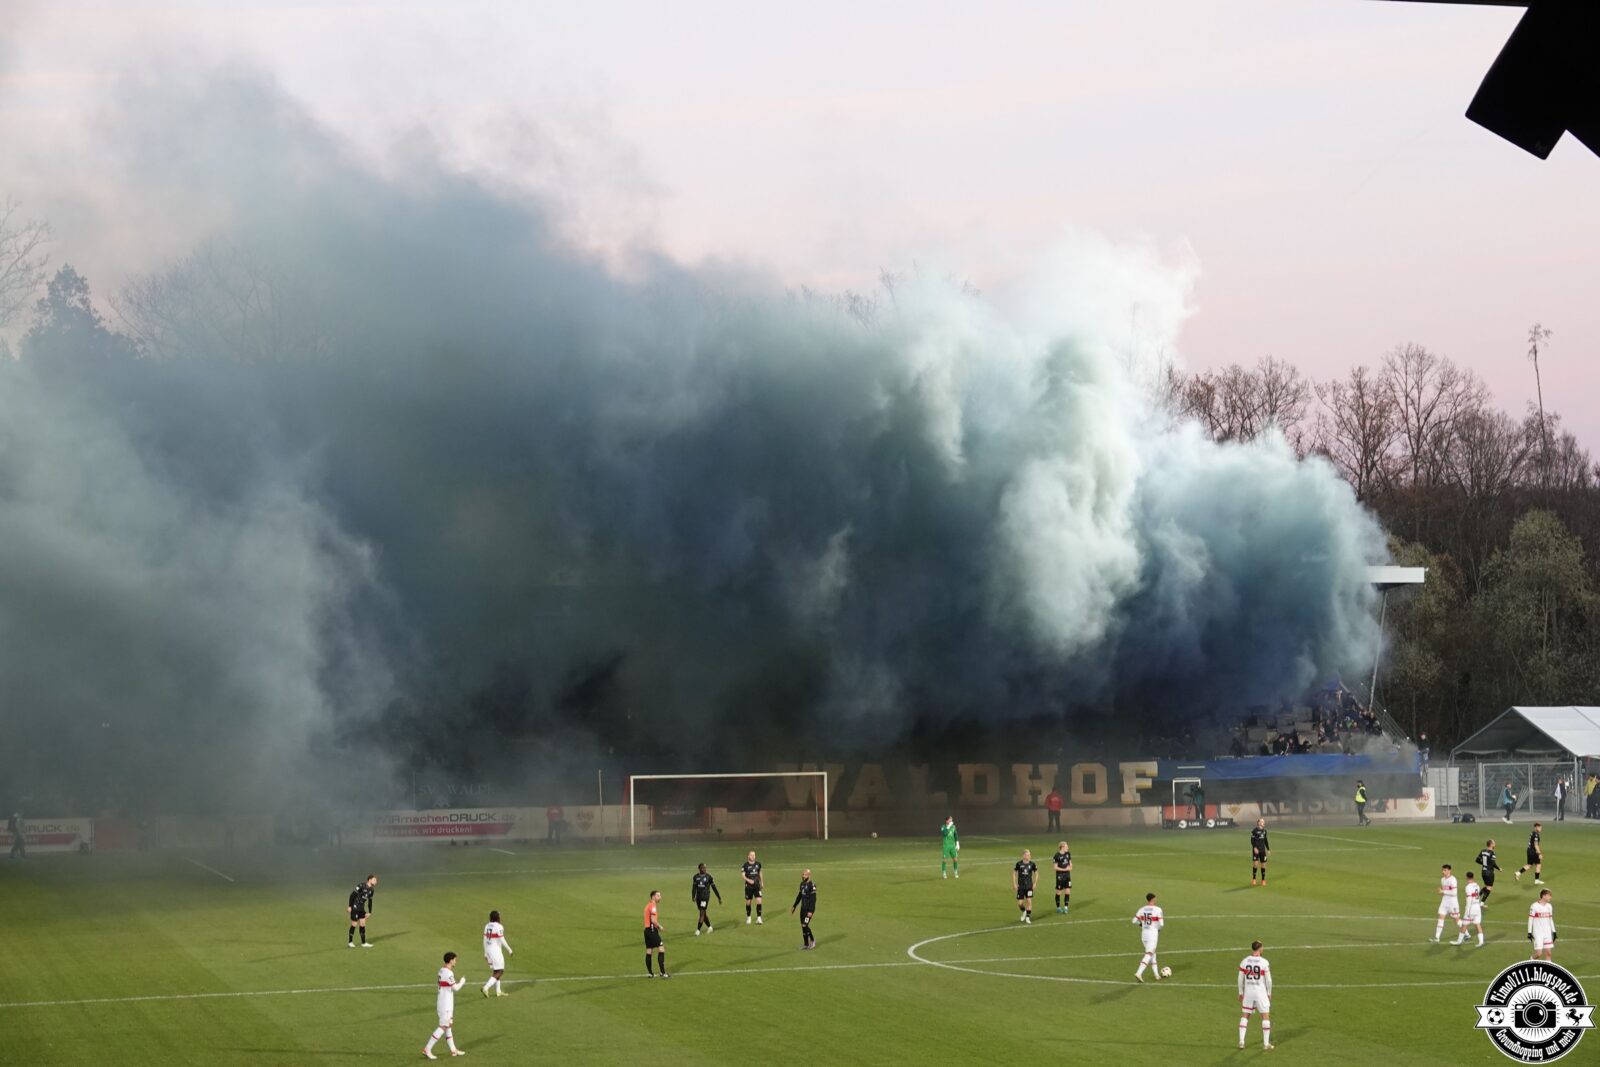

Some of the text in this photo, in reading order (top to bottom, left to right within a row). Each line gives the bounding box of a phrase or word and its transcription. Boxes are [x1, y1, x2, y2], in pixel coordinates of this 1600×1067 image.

[776, 761, 1158, 808] WALDHOF
[1144, 912, 1152, 926] 15
[1246, 965, 1261, 980] 29
